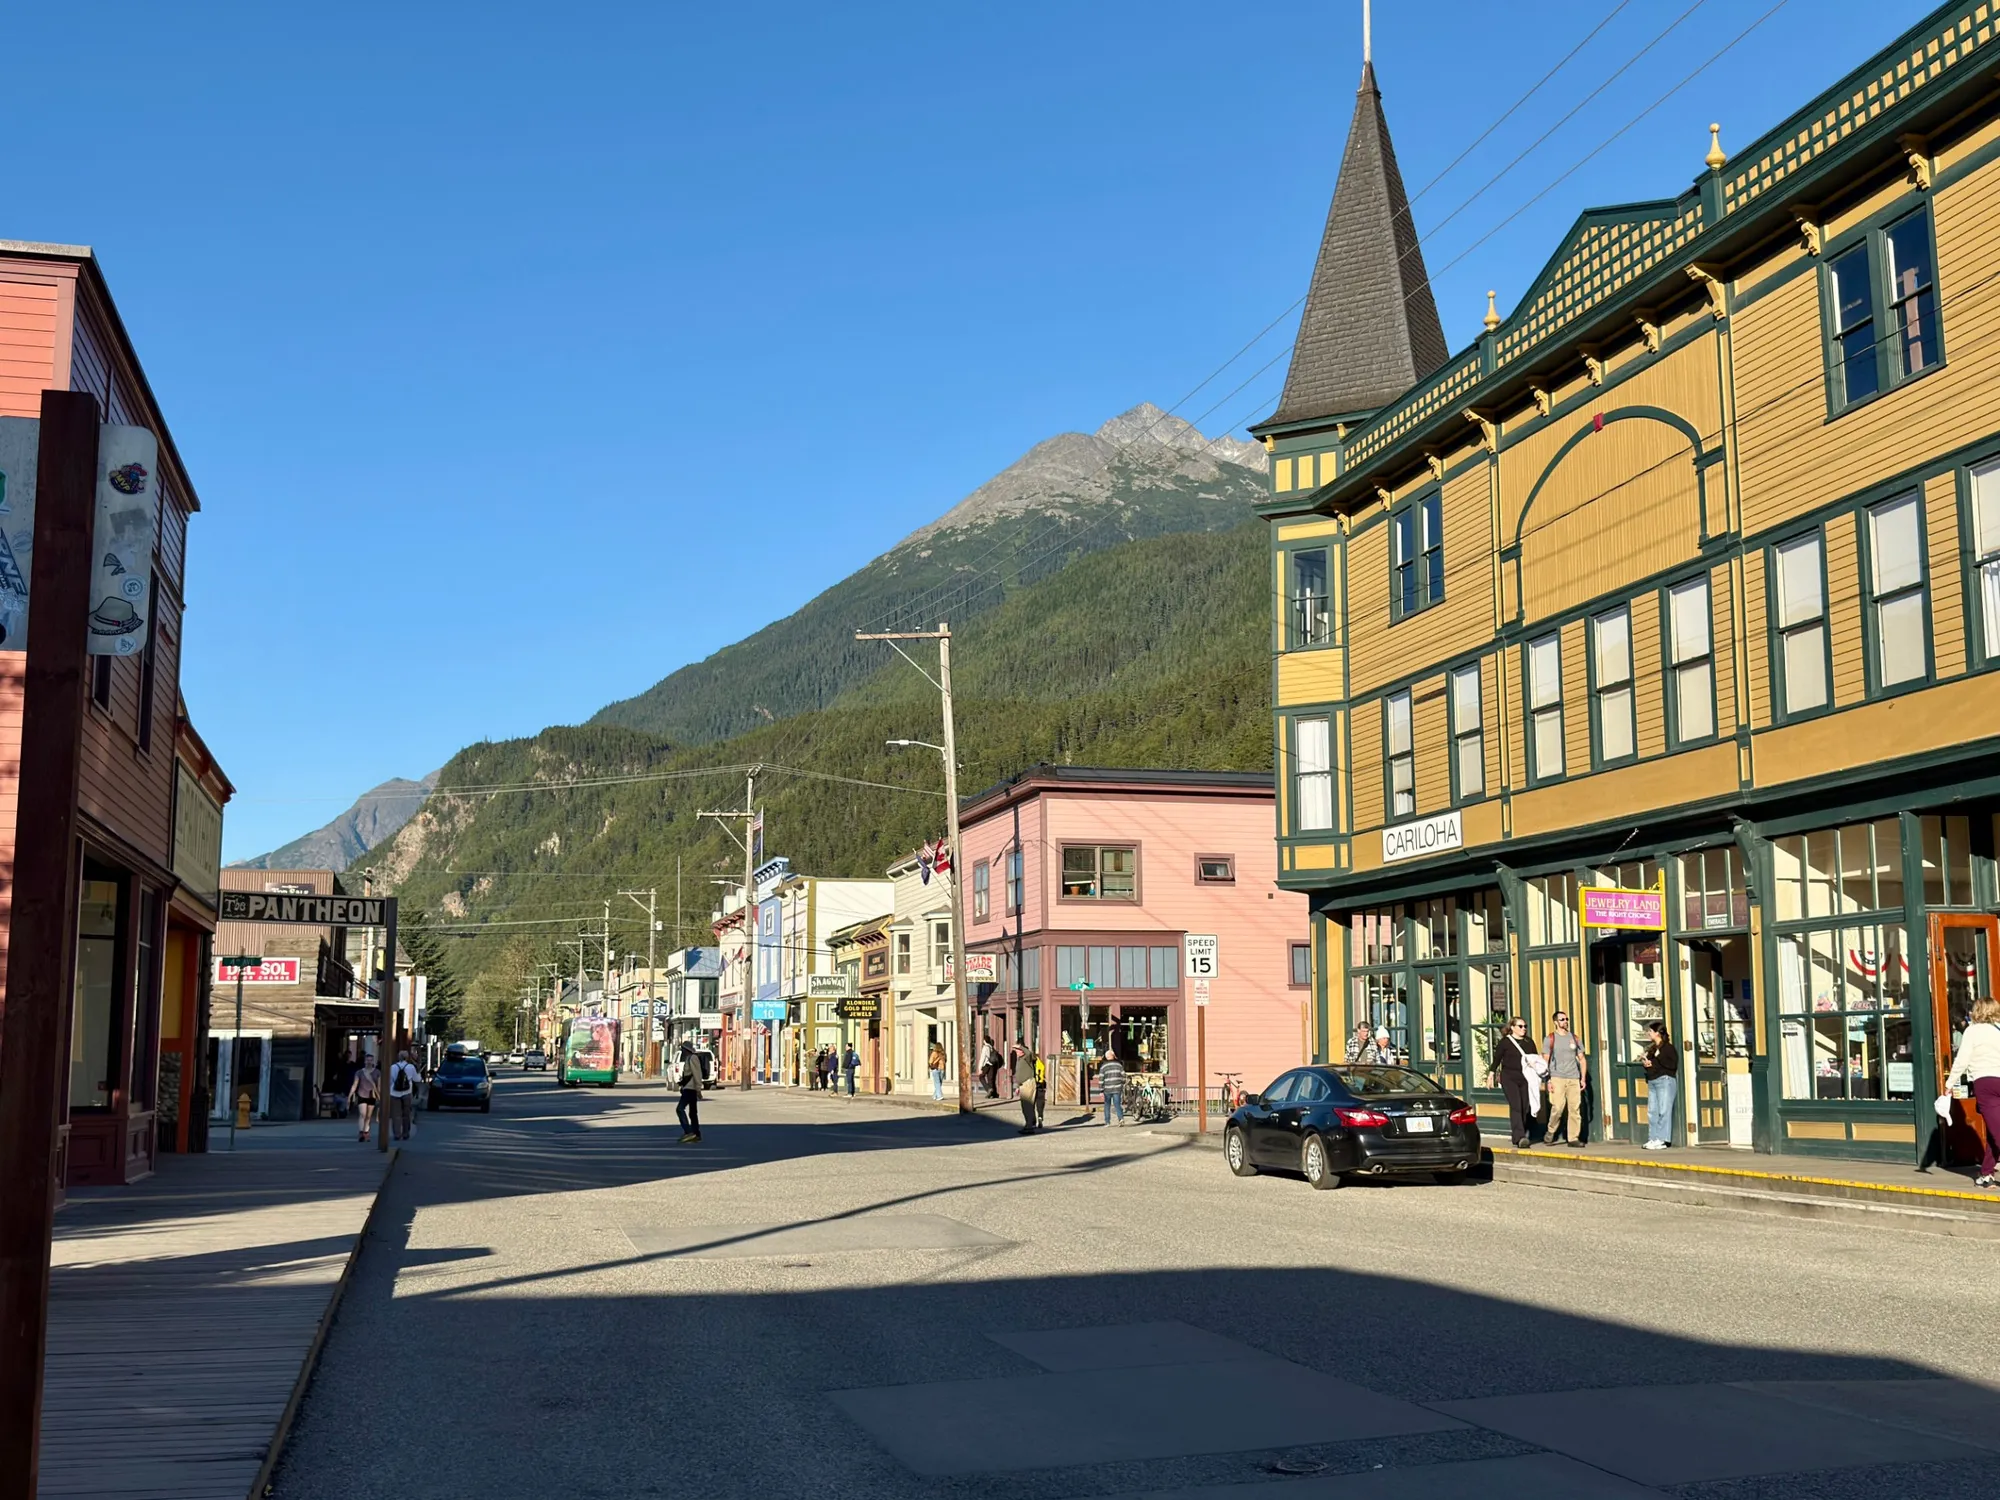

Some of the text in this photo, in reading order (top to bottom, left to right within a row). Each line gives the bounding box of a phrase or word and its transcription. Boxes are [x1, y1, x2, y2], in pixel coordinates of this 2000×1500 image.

[115, 473, 131, 491] MVP
[1386, 818, 1458, 856] CARILOHA
[248, 895, 381, 924] PANTHEON
[1586, 897, 1660, 911] JEWELRY LAND
[1627, 912, 1652, 920] CHOICE
[1187, 939, 1215, 947] SPEED
[1190, 948, 1212, 956] LIMIT
[260, 962, 290, 976] SOL
[1191, 957, 1211, 974] 15
[811, 976, 846, 988] SKAGWAY
[632, 1005, 667, 1015] CUROS
[763, 1009, 775, 1019] 10
